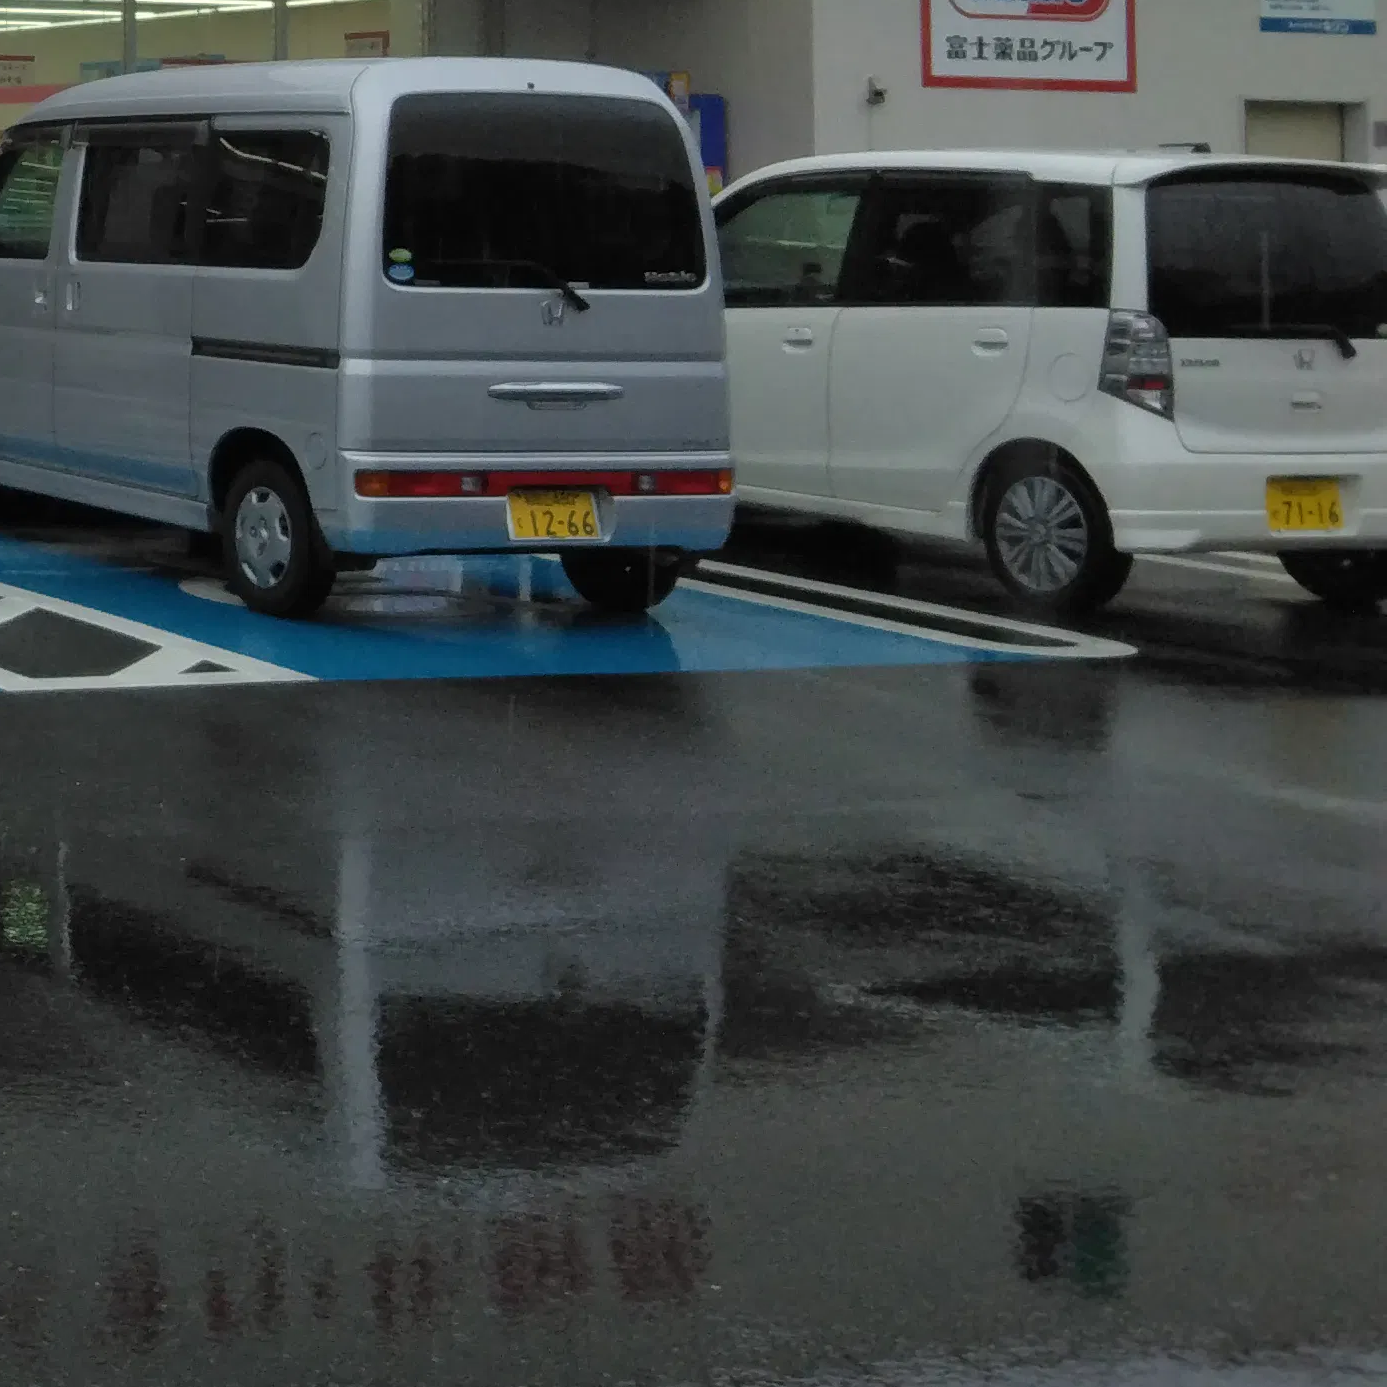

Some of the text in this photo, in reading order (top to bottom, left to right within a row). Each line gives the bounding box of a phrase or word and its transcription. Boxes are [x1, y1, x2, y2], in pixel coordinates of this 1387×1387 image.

[945, 34, 1115, 62] 富士薬品グループ
[529, 509, 595, 537] 12-66
